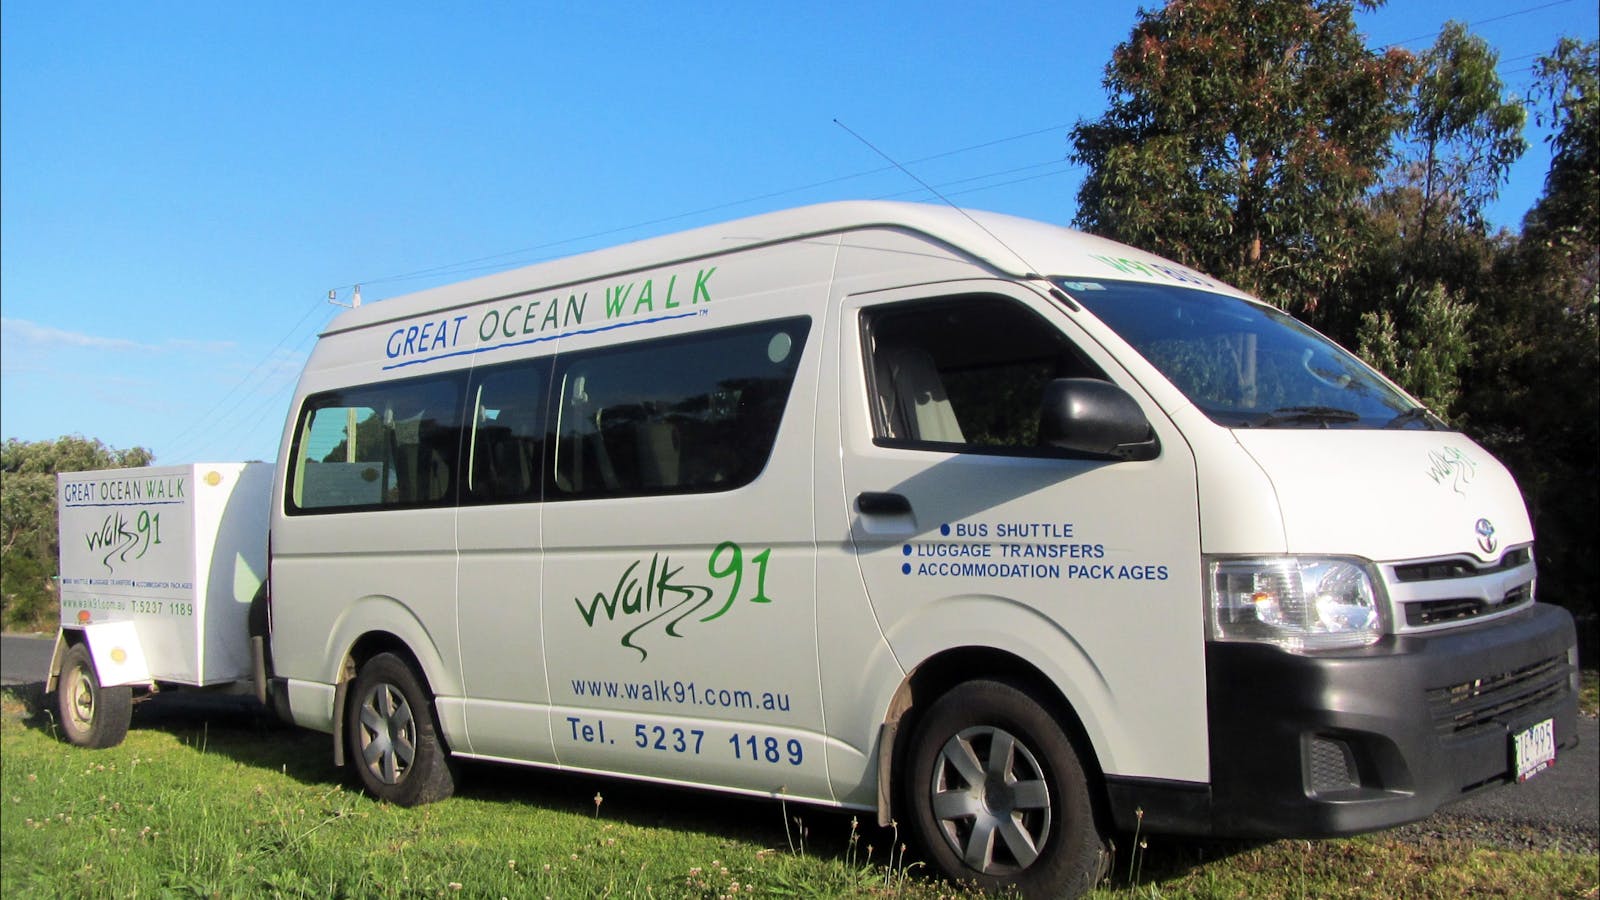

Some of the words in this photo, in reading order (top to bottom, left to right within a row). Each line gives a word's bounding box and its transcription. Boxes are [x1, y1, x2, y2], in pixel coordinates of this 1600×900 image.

[386, 315, 468, 358] GREAT
[479, 292, 588, 342] OCEAN
[605, 267, 717, 318] WALK
[64, 483, 96, 502] GREAT
[101, 481, 141, 500] OCEAN
[146, 479, 185, 498] WALK
[956, 523, 988, 538] BUS
[997, 524, 1074, 539] SHUTTLE
[917, 543, 992, 558] LUGGAGE
[1002, 544, 1105, 559] TRANSFERS
[917, 563, 1060, 579] ACCOMMODATION
[1068, 565, 1169, 580] PACKAGES
[170, 602, 192, 616] 1189
[570, 679, 791, 712] www.walk91.com.au
[567, 716, 615, 745] Tel.
[635, 723, 705, 754] 5237
[729, 732, 804, 766] 1189
